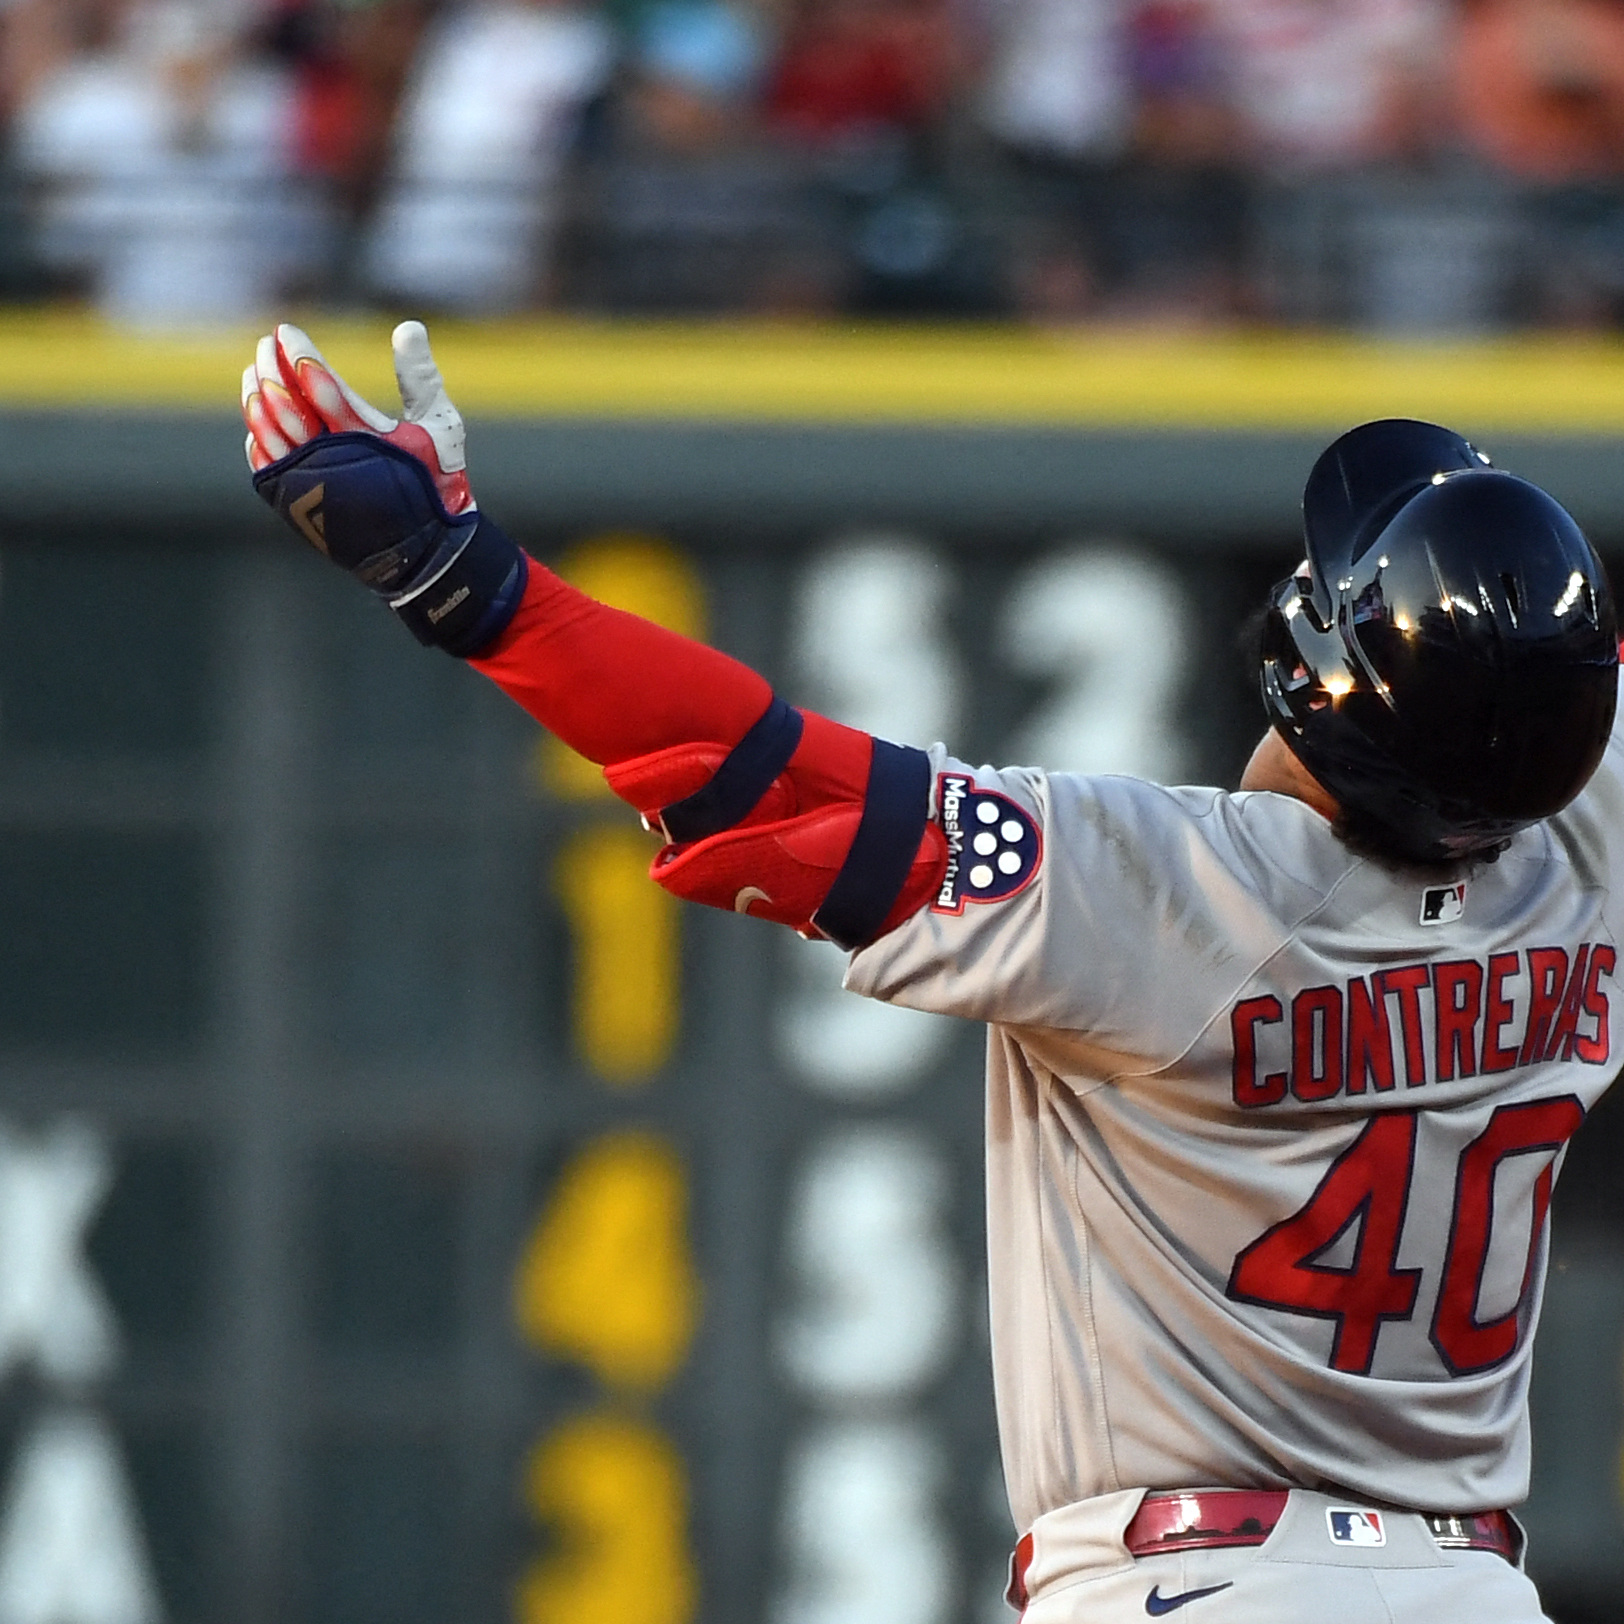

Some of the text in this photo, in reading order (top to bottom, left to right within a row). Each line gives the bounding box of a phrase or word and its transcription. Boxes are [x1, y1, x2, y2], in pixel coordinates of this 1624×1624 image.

[561, 830, 683, 1078] 1
[1231, 943, 1616, 1108] CONTRERAS
[519, 1132, 694, 1388] 4
[781, 1130, 954, 1392] 5
[1226, 1092, 1588, 1378] 40
